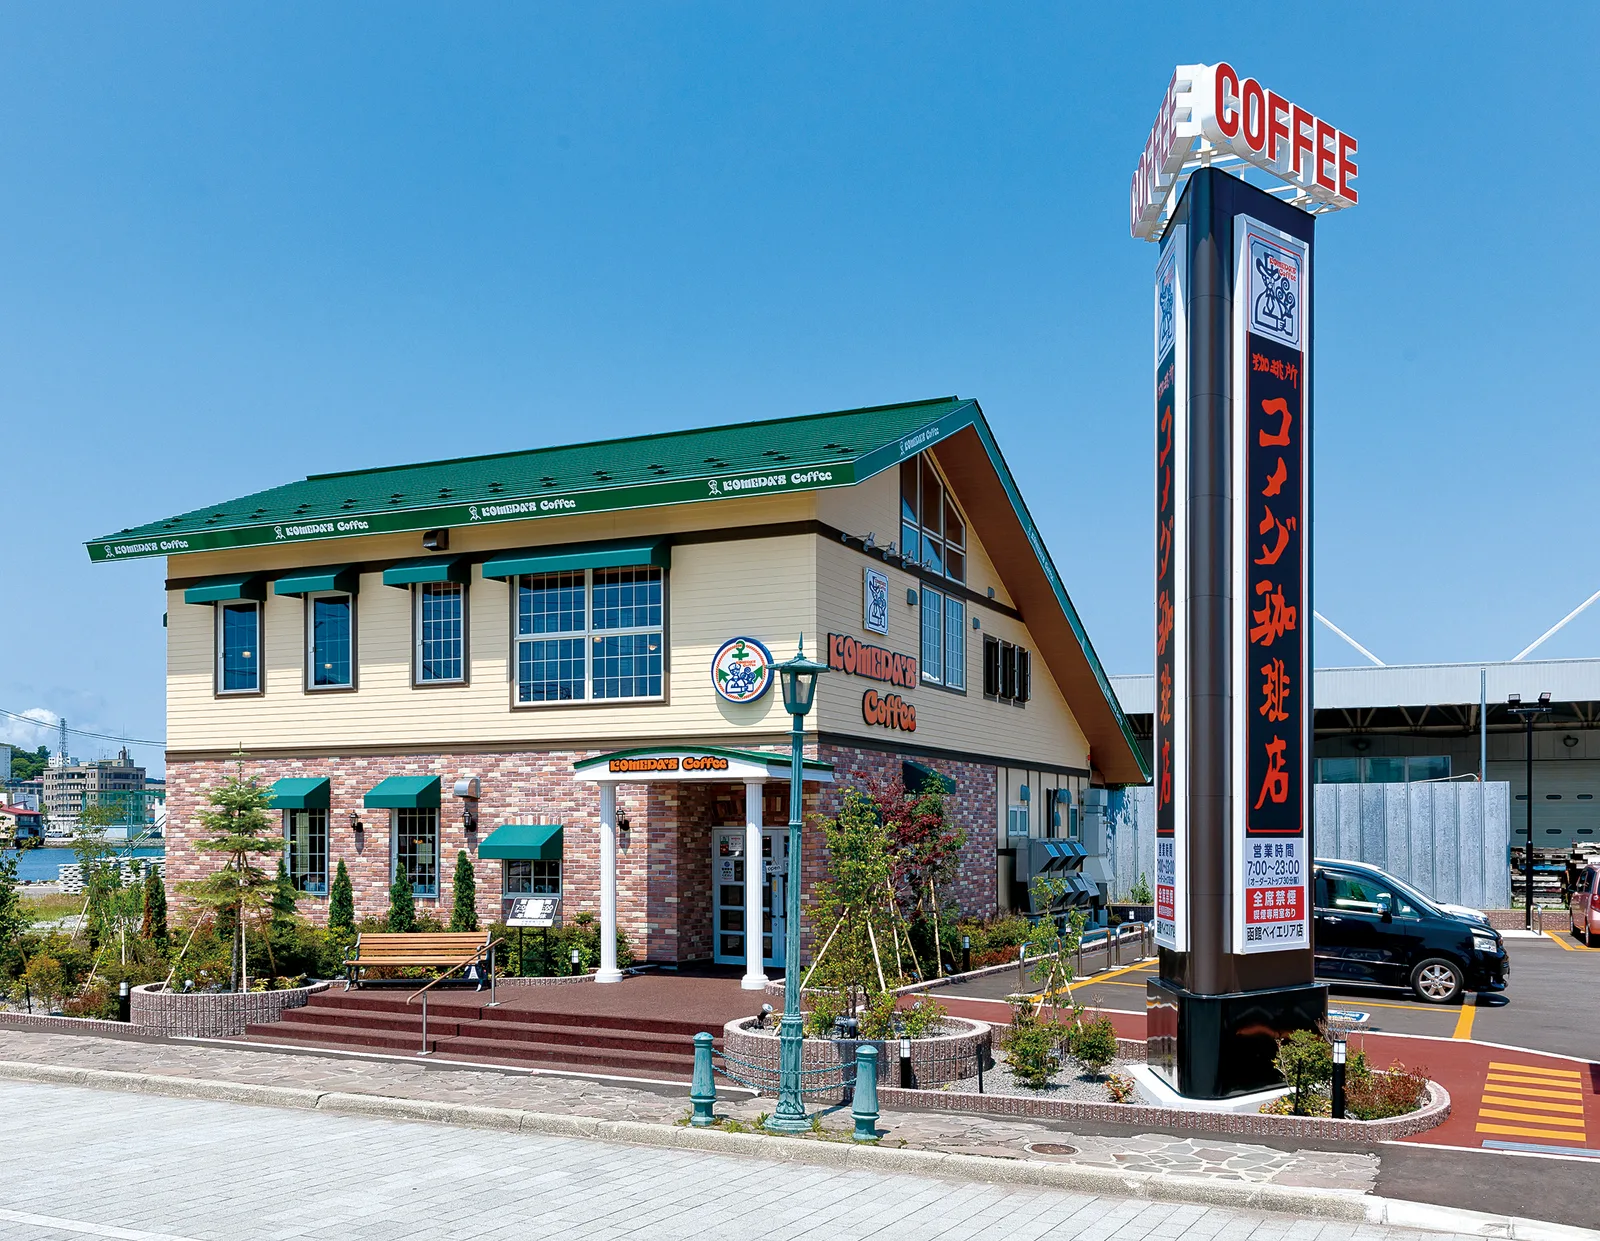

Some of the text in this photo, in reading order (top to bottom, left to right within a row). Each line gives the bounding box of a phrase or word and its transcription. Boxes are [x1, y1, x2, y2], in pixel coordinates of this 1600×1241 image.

[1214, 62, 1358, 204] COFFEE
[723, 470, 833, 491] KOMEDA'S Coffee
[481, 498, 576, 517] KOMEDA'S Coffee
[285, 519, 369, 536] KOMEDA'S Coffee
[160, 539, 189, 550] Coffee
[1250, 397, 1297, 810] コメダ珈琲店
[828, 633, 917, 689] KOMEDA'S
[862, 689, 917, 732] Coffee
[609, 756, 729, 773] KOMEDA'S Coffee
[1253, 843, 1295, 858] 営業時間
[1253, 889, 1297, 907] 全席禁煙
[1246, 923, 1303, 941] 函館ベイエリア店
